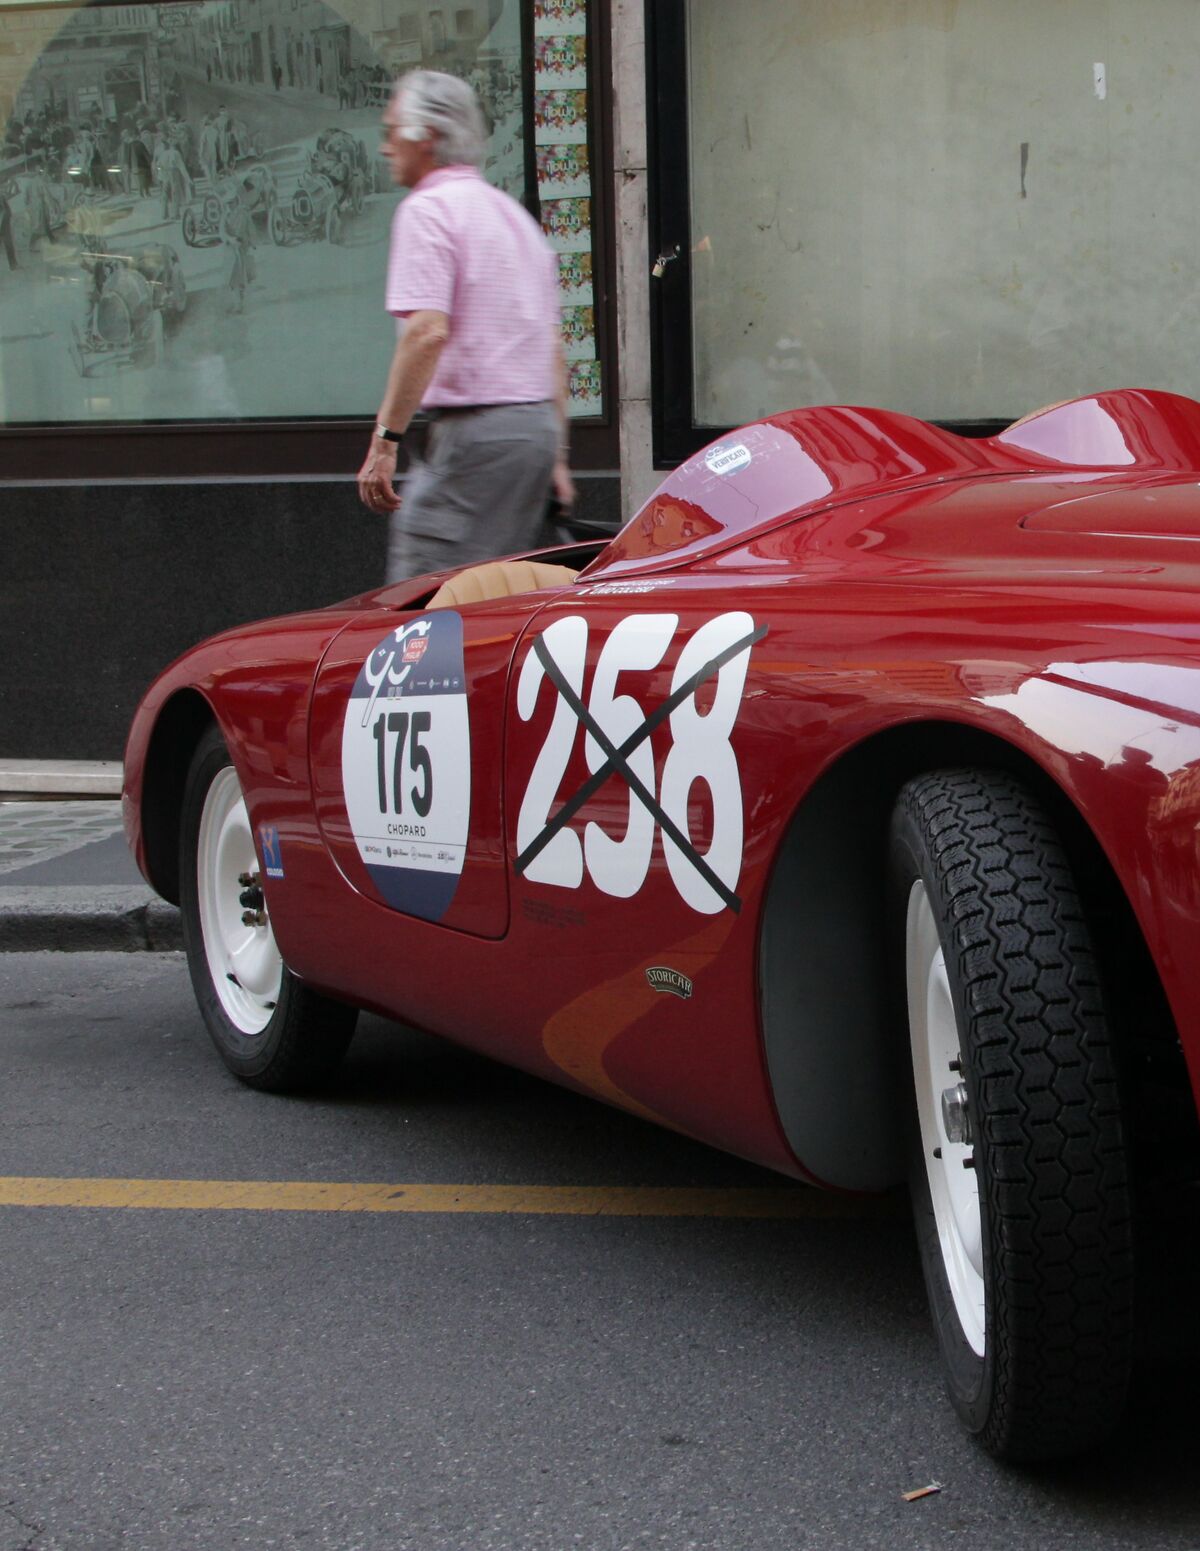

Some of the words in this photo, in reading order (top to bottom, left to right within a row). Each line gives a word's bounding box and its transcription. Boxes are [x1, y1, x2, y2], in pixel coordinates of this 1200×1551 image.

[712, 449, 746, 469] VERIFICATO
[372, 710, 433, 819] 175
[516, 611, 755, 915] 258
[387, 823, 427, 838] CHOPARD
[647, 969, 691, 992] STORICAR
